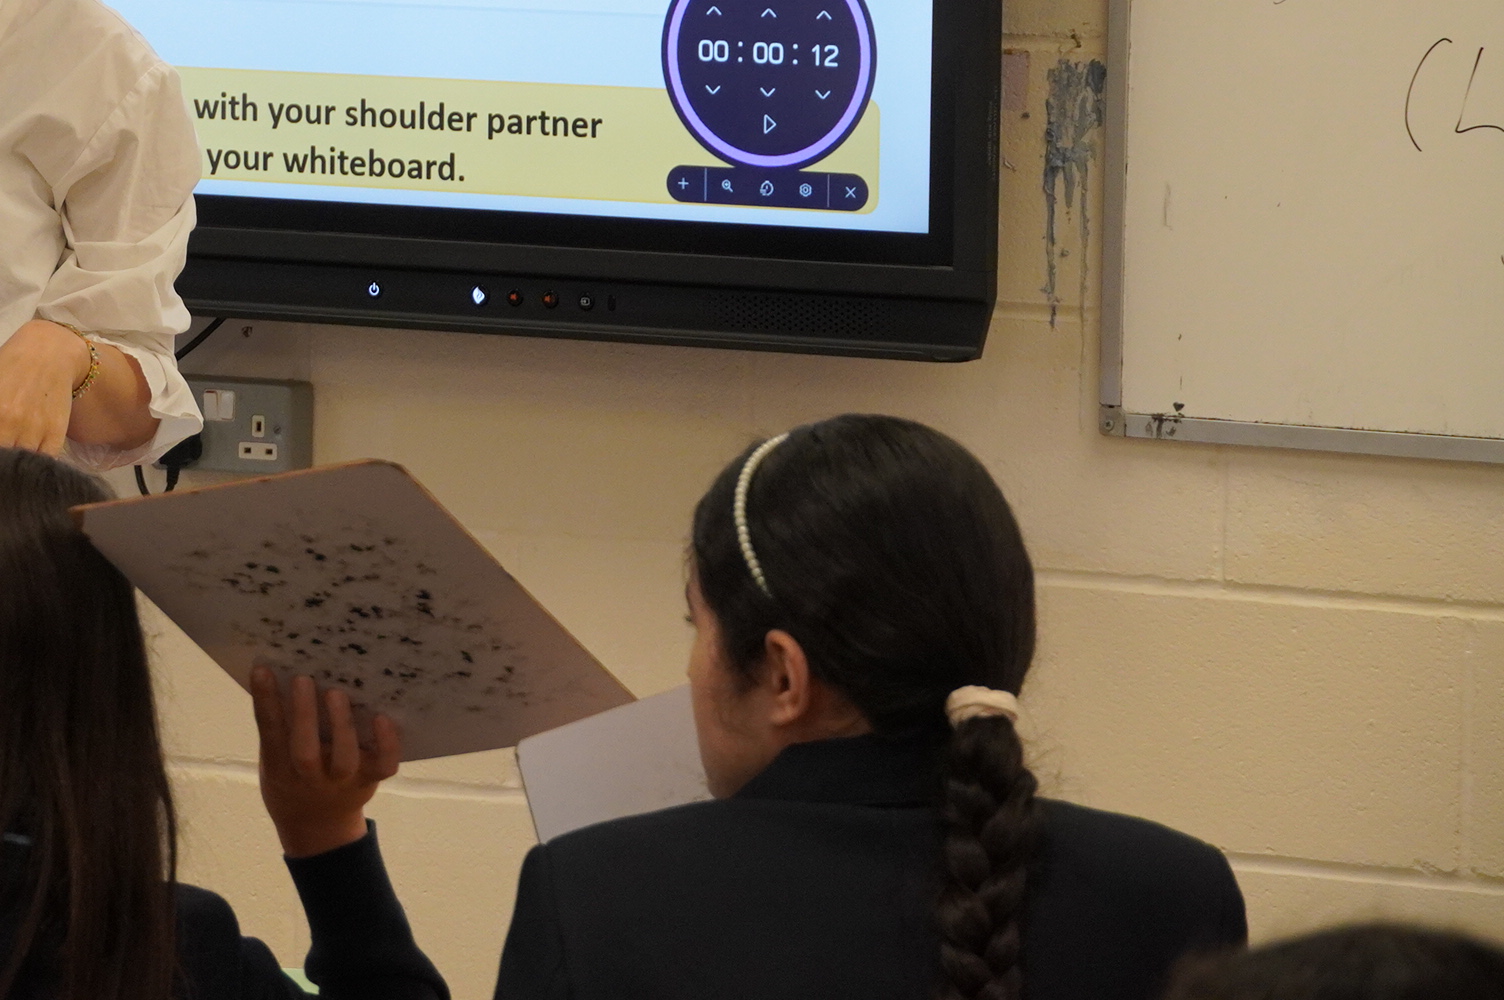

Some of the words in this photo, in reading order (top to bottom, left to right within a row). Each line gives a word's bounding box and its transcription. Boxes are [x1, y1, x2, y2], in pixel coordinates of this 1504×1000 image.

[194, 92, 258, 121] with
[268, 103, 336, 129] your
[345, 98, 477, 132] shoulder
[487, 109, 603, 139] partner
[206, 148, 274, 175] your
[283, 145, 465, 181] whiteboard.
